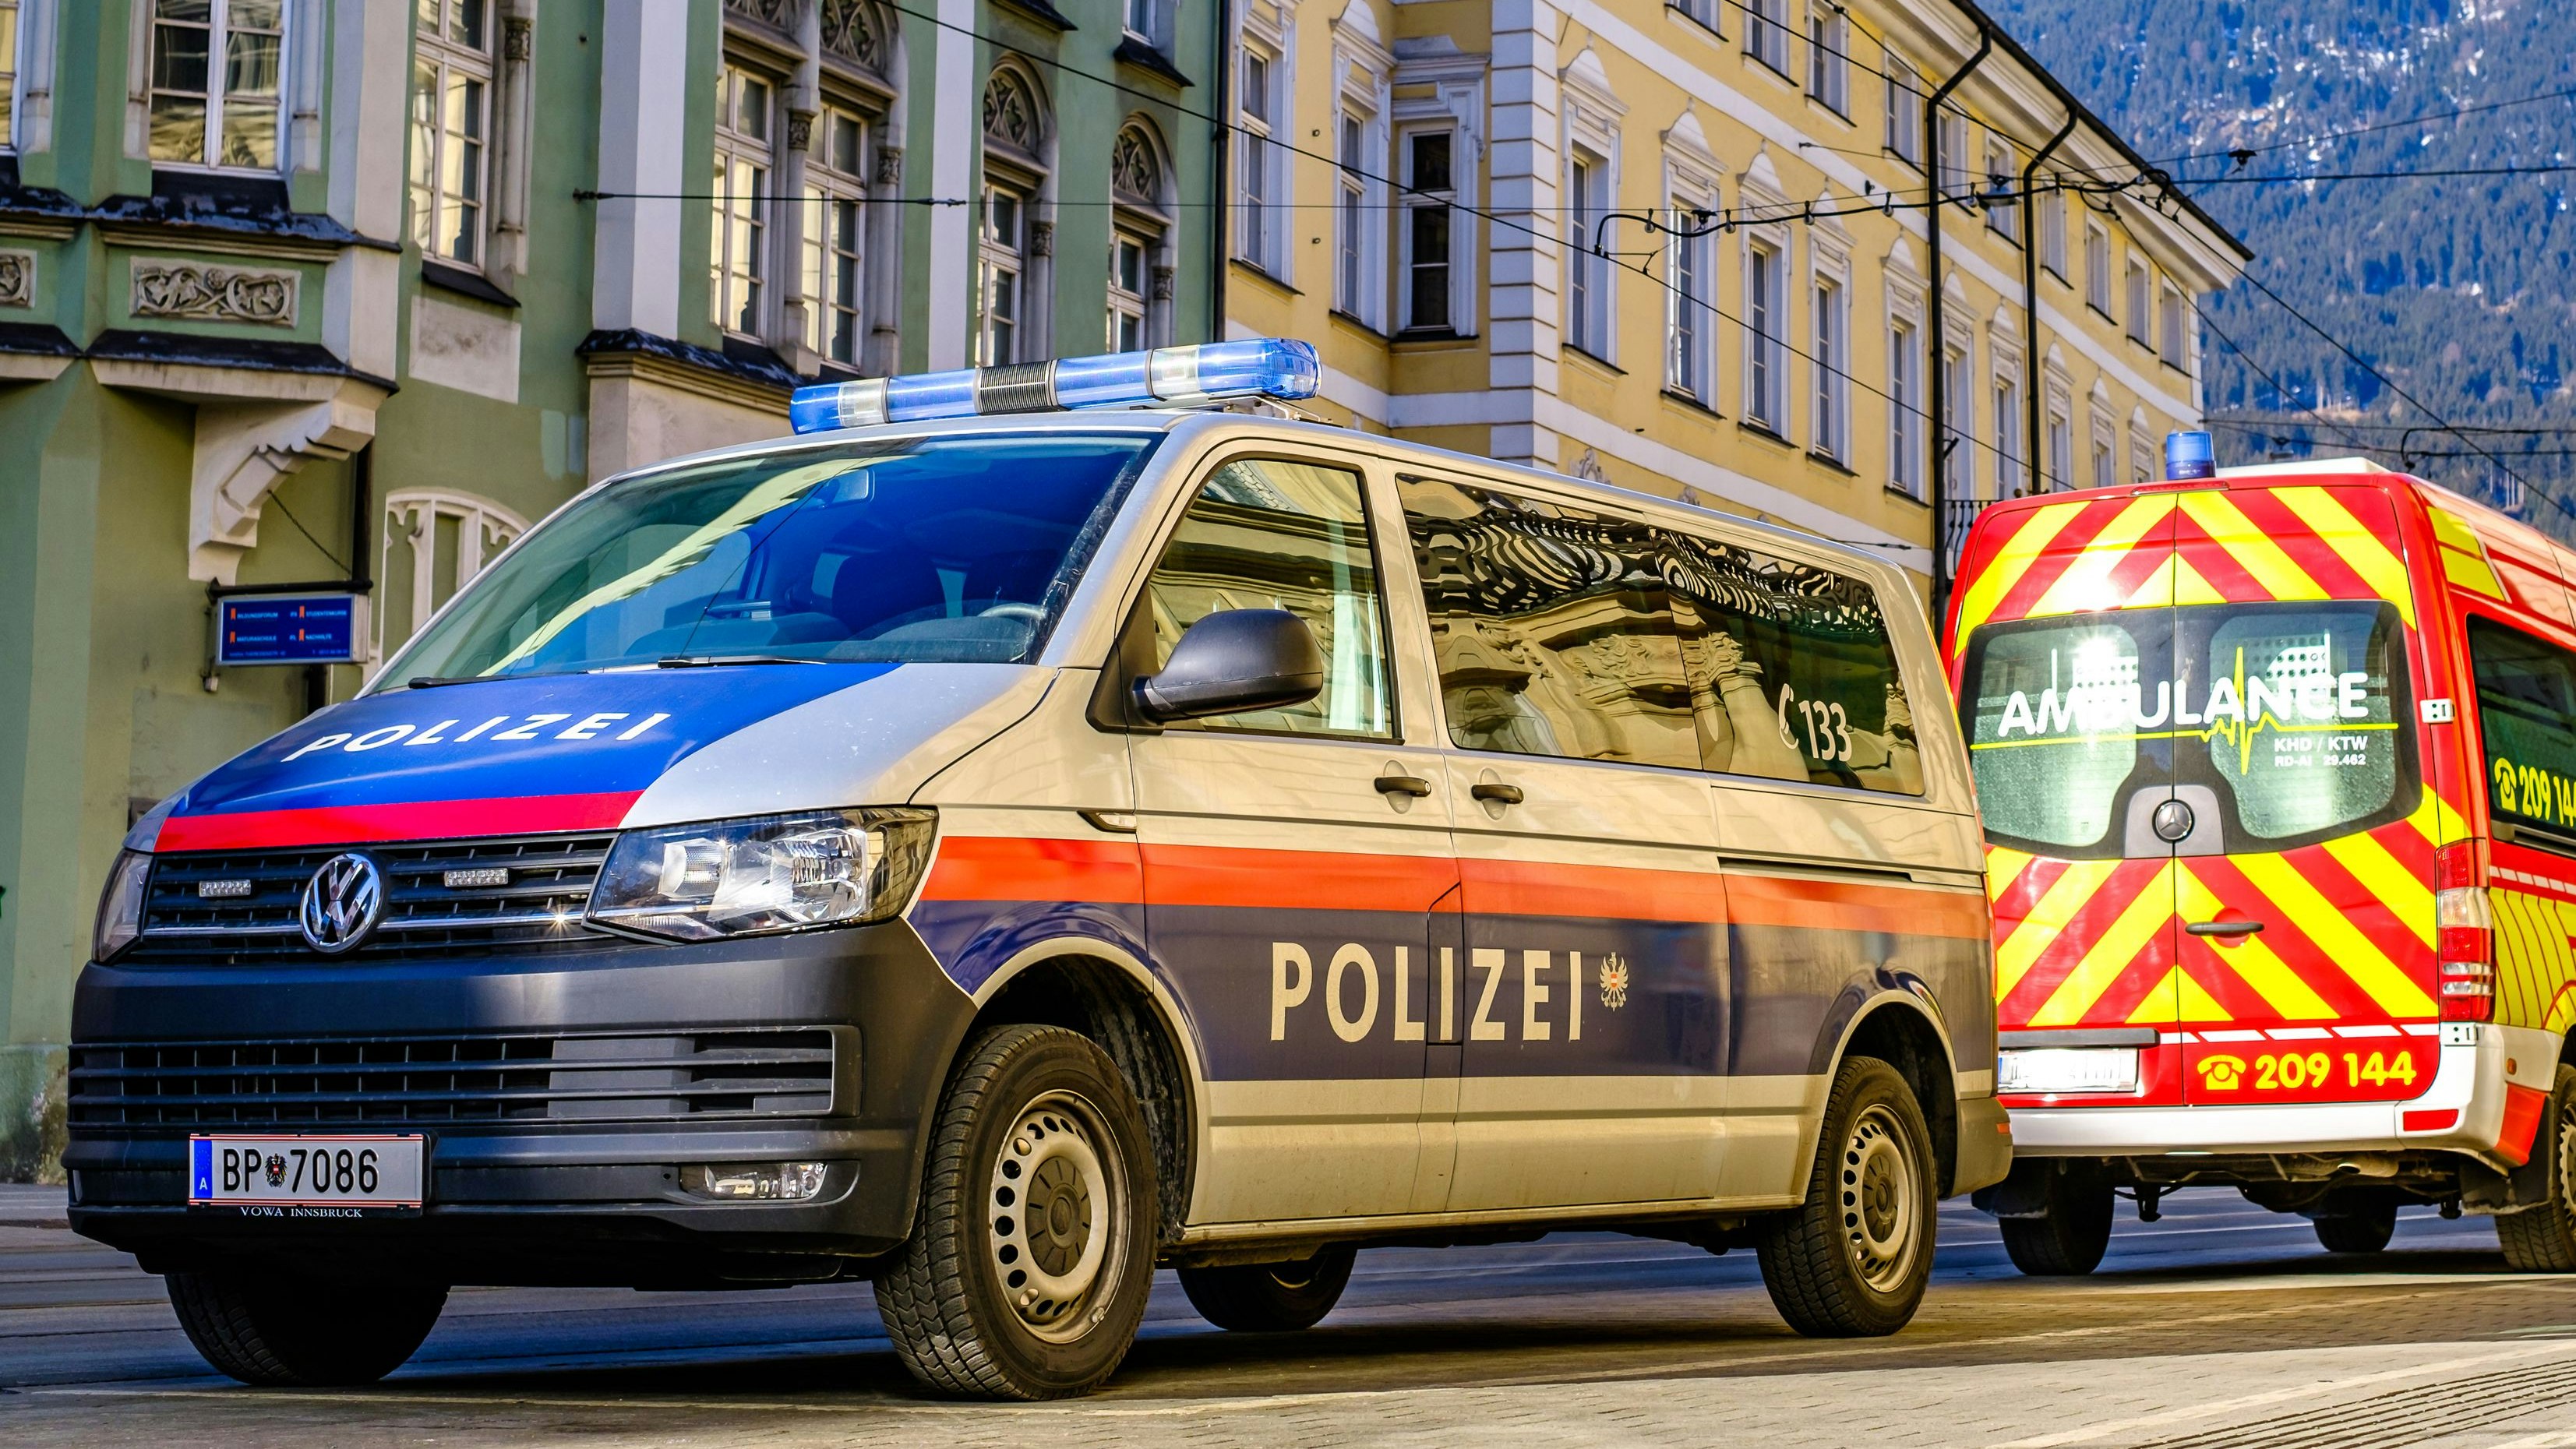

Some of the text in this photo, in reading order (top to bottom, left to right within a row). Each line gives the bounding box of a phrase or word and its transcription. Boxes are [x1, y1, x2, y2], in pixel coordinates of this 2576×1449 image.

[280, 713, 672, 763] POLIZEI
[1798, 700, 1852, 762] 133
[2274, 737, 2313, 752] KHD
[2328, 735, 2368, 751] KTW
[2519, 765, 2576, 827] 209 14
[1271, 942, 1582, 1042] POLIZEI
[2255, 1050, 2417, 1089] 209 144
[199, 1176, 208, 1190] A
[223, 1148, 379, 1193] BP 7086
[240, 1207, 363, 1218] VOWA INNSBRUCK
